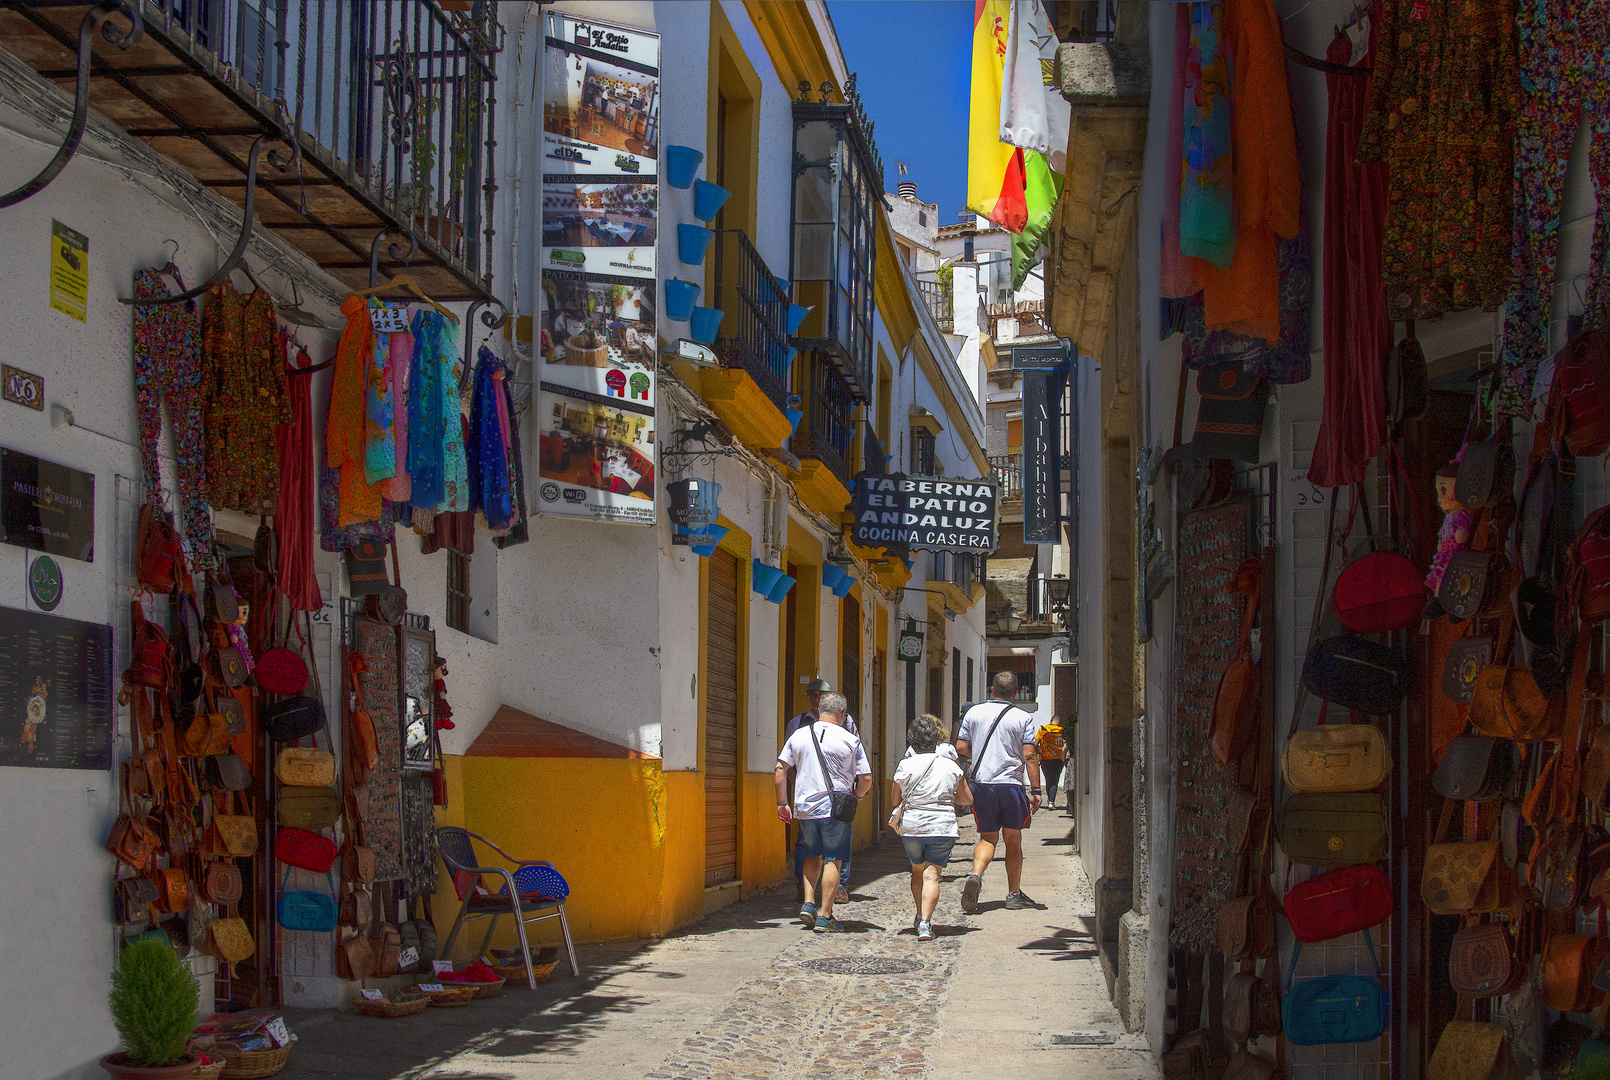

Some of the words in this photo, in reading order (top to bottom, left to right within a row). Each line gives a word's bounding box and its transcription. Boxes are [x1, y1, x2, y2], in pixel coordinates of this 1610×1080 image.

[592, 30, 605, 40] El
[606, 32, 629, 45] Patio
[592, 38, 629, 53] Andaluz
[544, 136, 556, 144] Nos
[544, 175, 588, 184] TERRAZA
[590, 176, 602, 184] AL
[606, 176, 625, 184] AIRE
[628, 176, 652, 184] LIBRE
[552, 250, 562, 258] AD
[545, 270, 574, 280] PATIO
[609, 276, 653, 287] ANDALUZ
[392, 309, 400, 319] 3
[570, 388, 584, 398] CON
[1034, 404, 1049, 518] Albahaca
[864, 478, 992, 498] TABERNA
[868, 494, 899, 508] EL
[909, 496, 988, 514] PATIO
[860, 510, 992, 530] ANDALUZ
[858, 526, 920, 543] COCINA
[926, 531, 990, 548] CASERA
